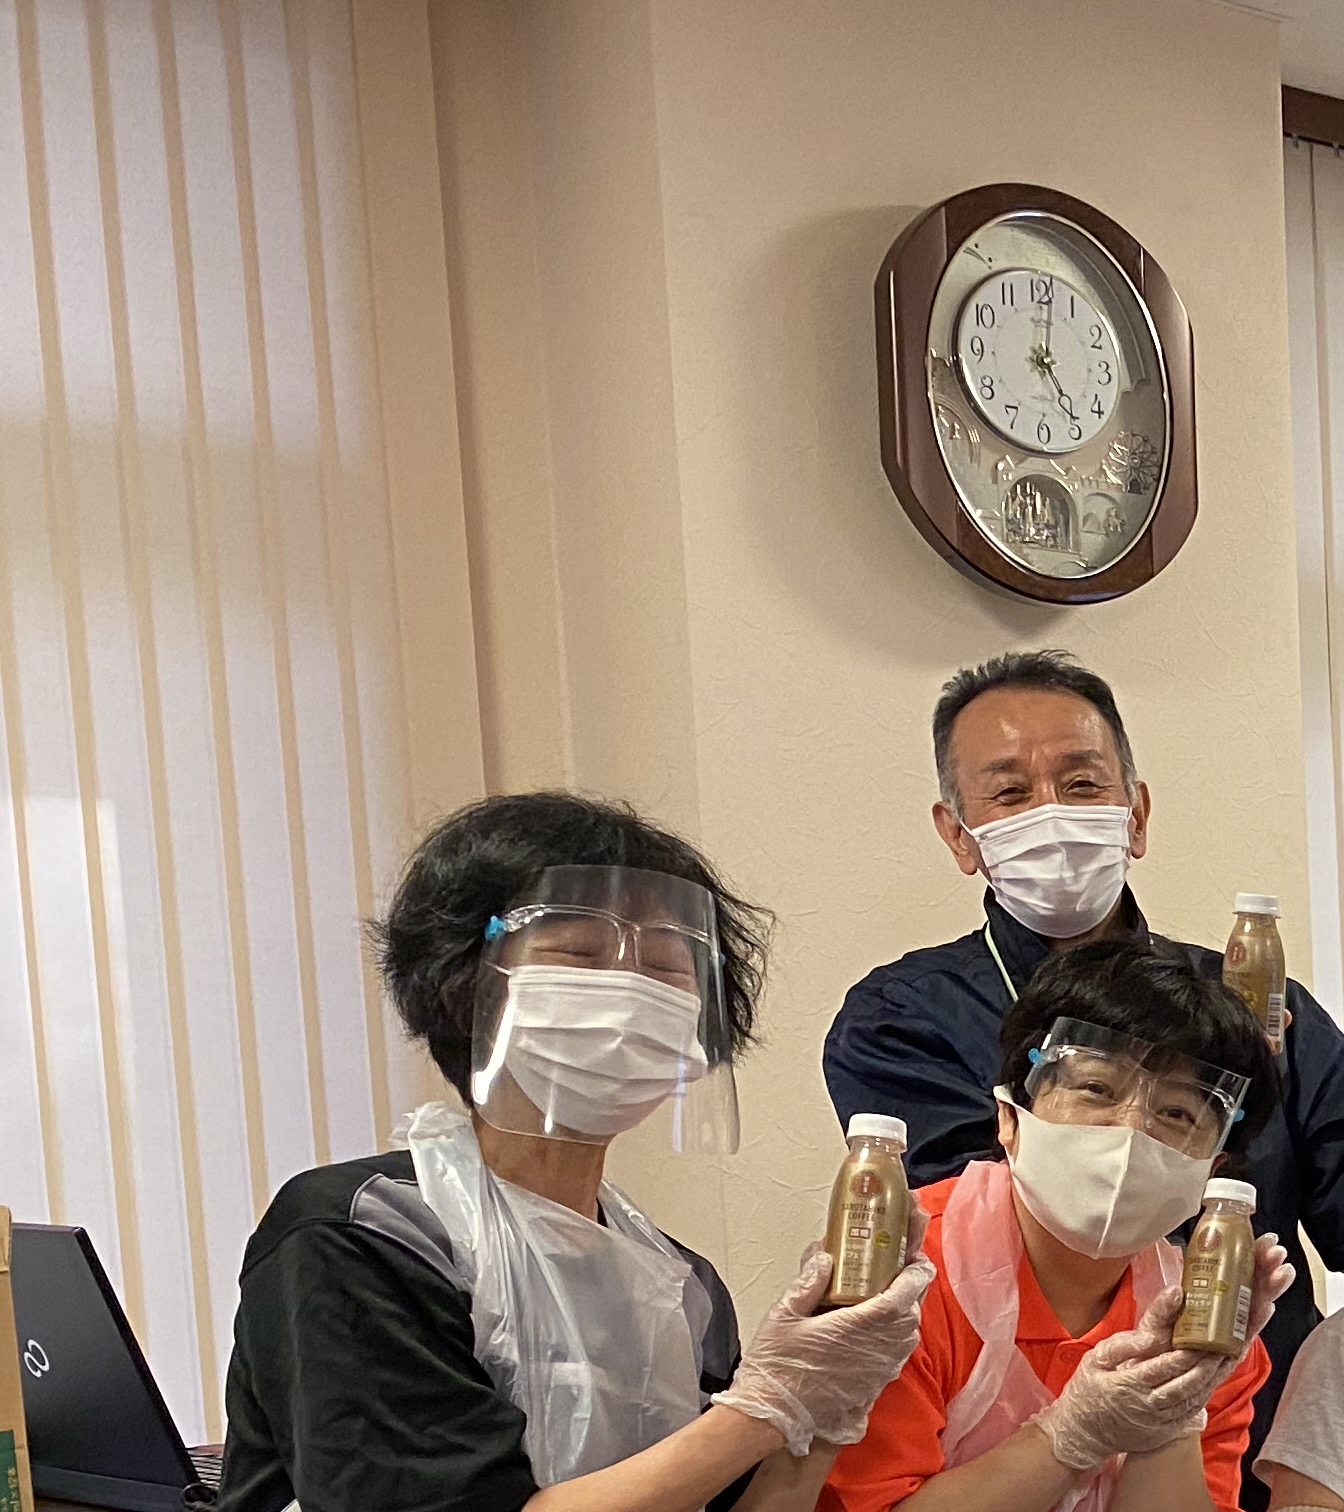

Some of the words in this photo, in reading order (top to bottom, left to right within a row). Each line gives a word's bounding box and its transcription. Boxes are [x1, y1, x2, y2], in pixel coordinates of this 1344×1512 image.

[1001, 282, 1016, 306] 11
[975, 303, 996, 329] 10
[1069, 296, 1075, 318] 1
[969, 335, 985, 363] 9
[1089, 324, 1103, 350] 2
[1097, 361, 1112, 386] 3
[981, 375, 995, 400] 8
[1004, 406, 1019, 429] 7
[1090, 394, 1105, 419] 4
[1036, 417, 1051, 444] 6
